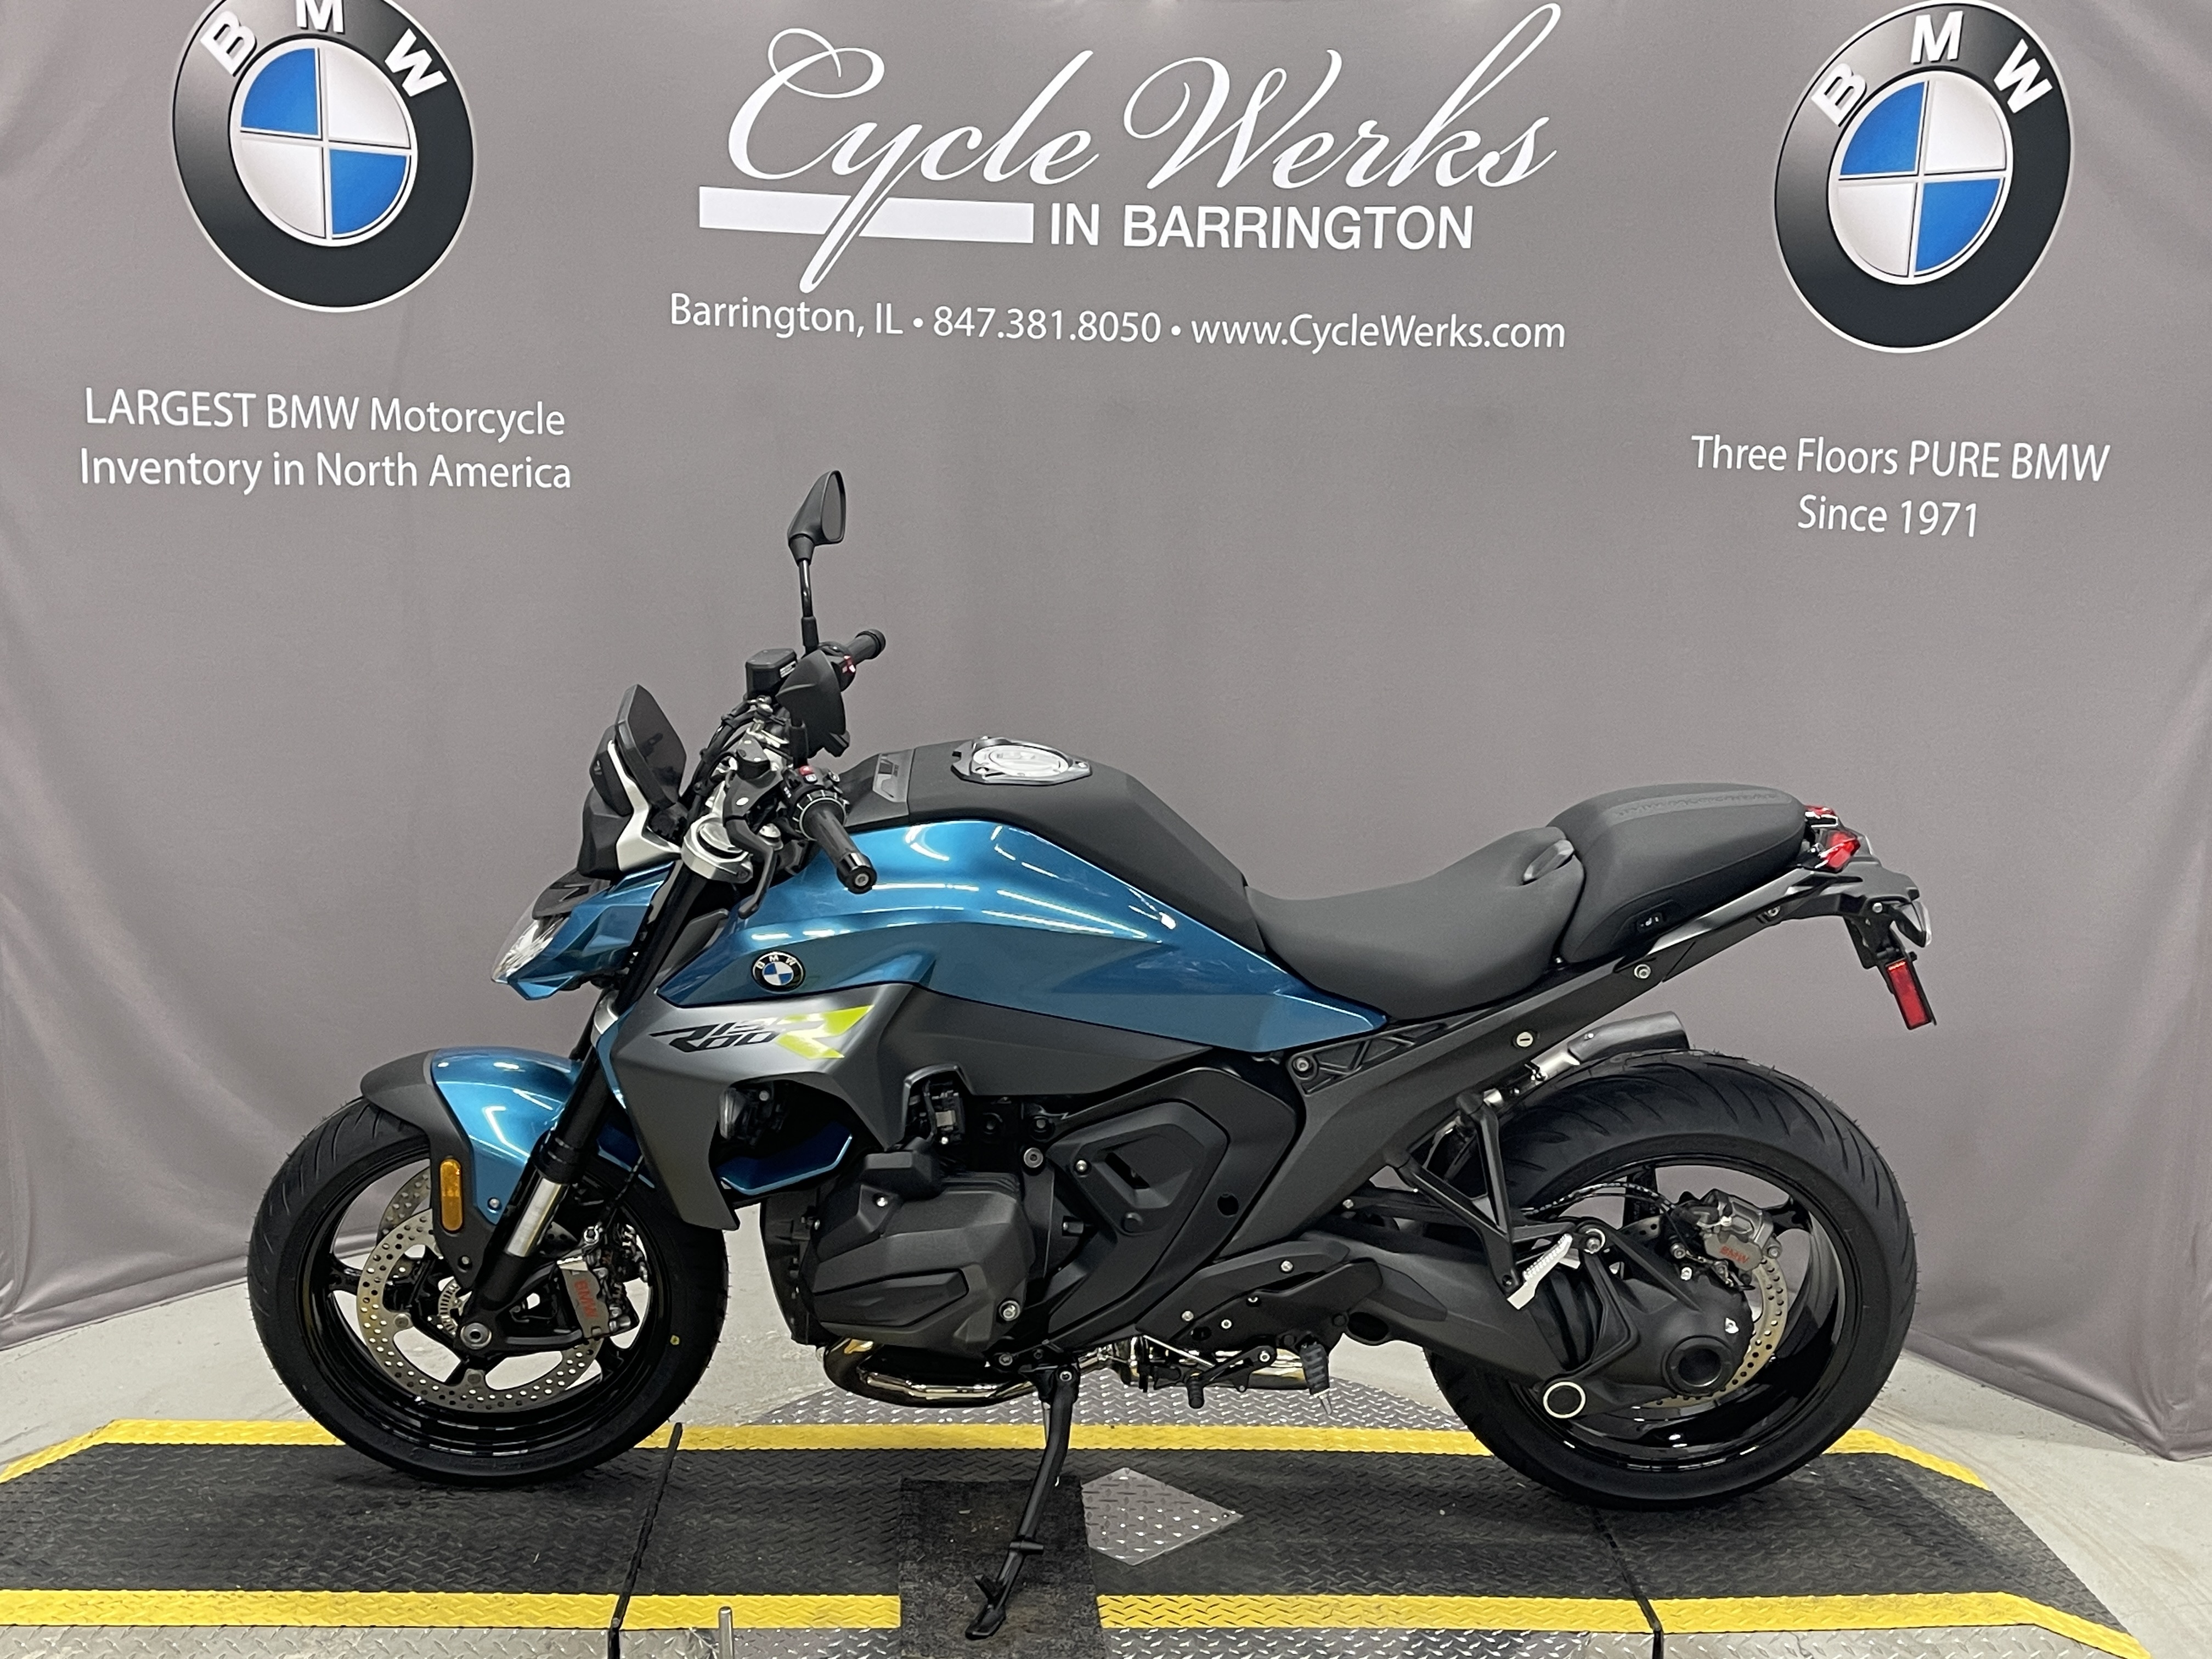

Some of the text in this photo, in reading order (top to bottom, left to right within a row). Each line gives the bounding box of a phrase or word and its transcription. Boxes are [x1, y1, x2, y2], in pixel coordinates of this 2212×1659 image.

[200, 0, 447, 97] BMW
[1810, 10, 2053, 127] BMW
[728, 3, 1561, 294] Cycle Werks
[1051, 202, 1474, 250] IN BARRINGTON
[672, 292, 1565, 354] Barrington, IL 847.381.8050 www.CycleWerks.com
[86, 387, 565, 443] LARGEST BMW Motorcycle
[81, 448, 571, 495] Inventory in North America
[1691, 434, 2111, 482] Three Floors PURE BMW
[1798, 494, 1976, 537] Since 1971
